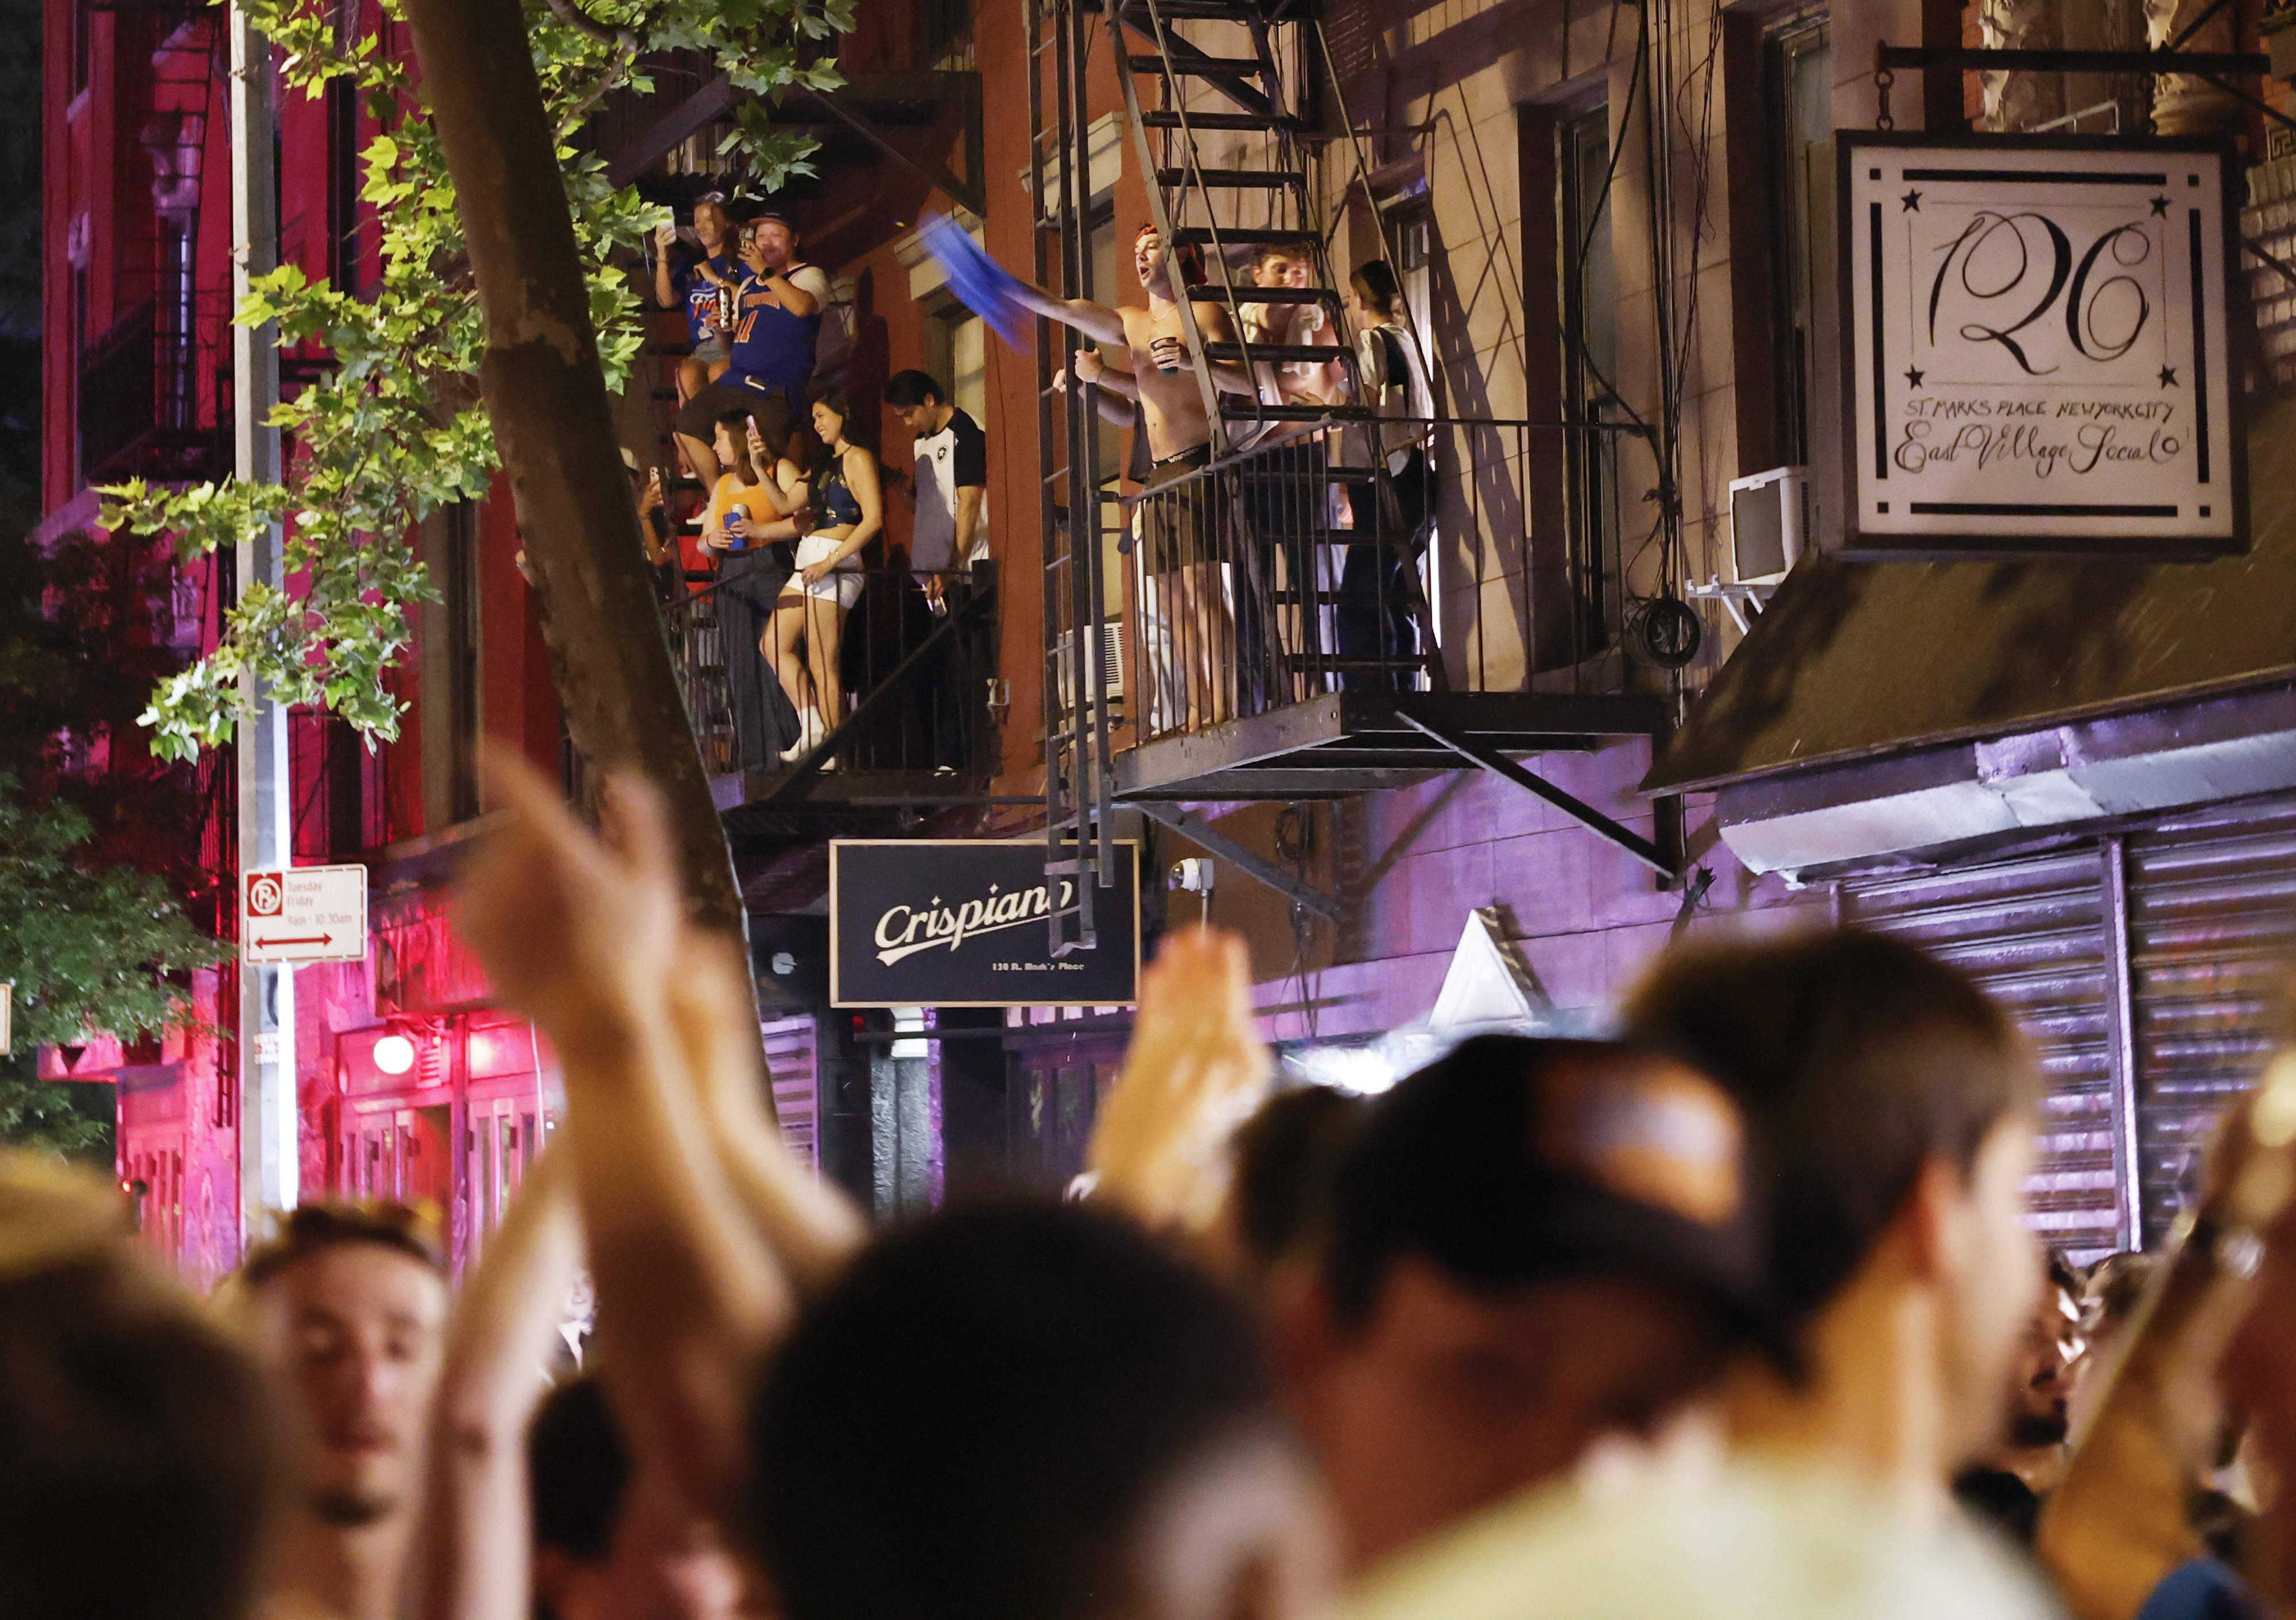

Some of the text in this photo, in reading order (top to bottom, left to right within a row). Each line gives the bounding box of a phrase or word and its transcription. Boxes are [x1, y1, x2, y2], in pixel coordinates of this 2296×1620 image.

[1929, 210, 2150, 375] 126
[1998, 401, 2046, 417] PLACE
[2056, 402, 2095, 417] NEW
[2134, 402, 2174, 424] CITY
[1894, 420, 1961, 474] East
[1953, 423, 2068, 478] Village
[287, 881, 323, 892] Tuesday
